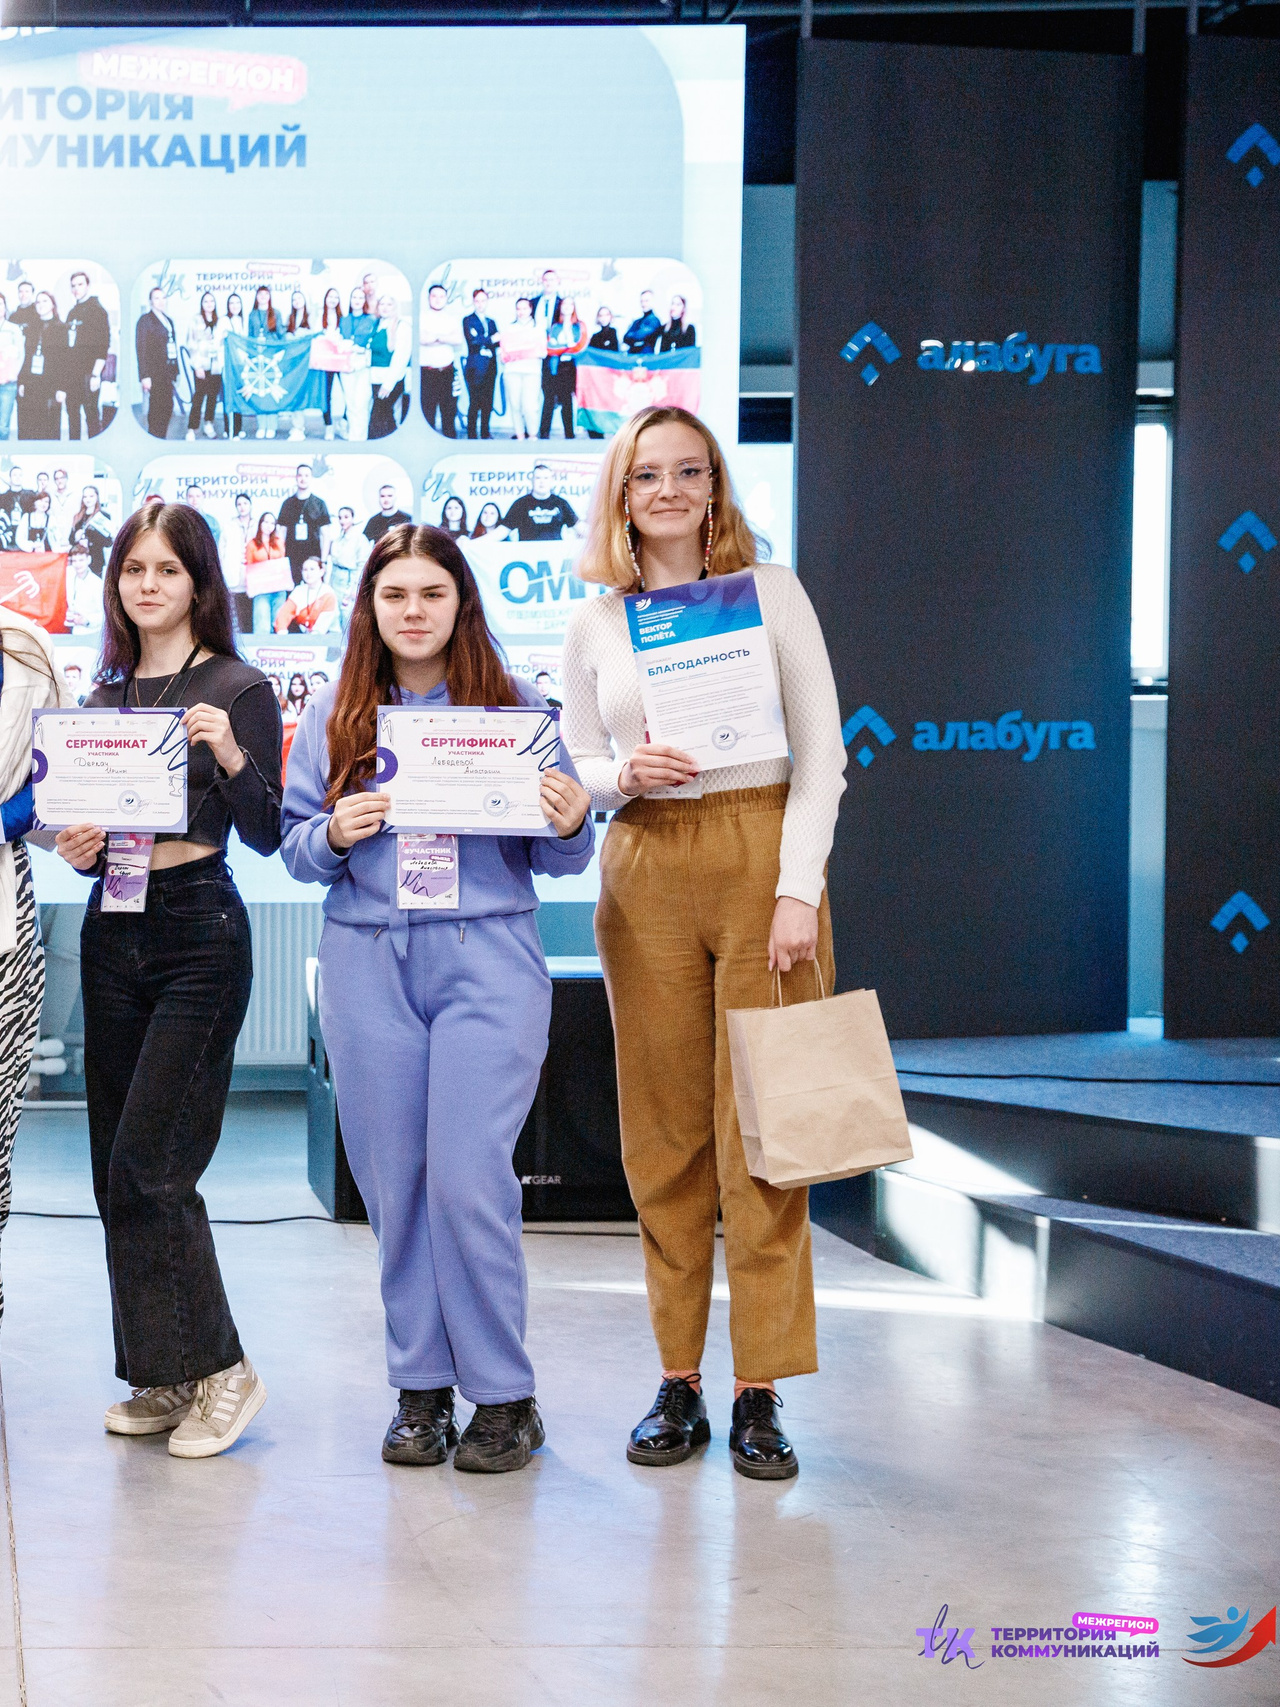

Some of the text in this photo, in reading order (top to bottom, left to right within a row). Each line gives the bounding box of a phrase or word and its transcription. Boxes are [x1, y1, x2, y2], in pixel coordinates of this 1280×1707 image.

[91, 52, 295, 92] МЕЖРЕГИОН
[918, 332, 1103, 385] алабуга
[639, 622, 673, 635] ВЕКТОР
[641, 629, 676, 644] ПОЛЁТА
[647, 648, 751, 677] БЛАГОДАРНОСТЬ
[66, 739, 148, 749] СЕРТИФИКАТ
[421, 737, 517, 748] СЕРТИФИКАТ
[913, 711, 1097, 762] алабуга
